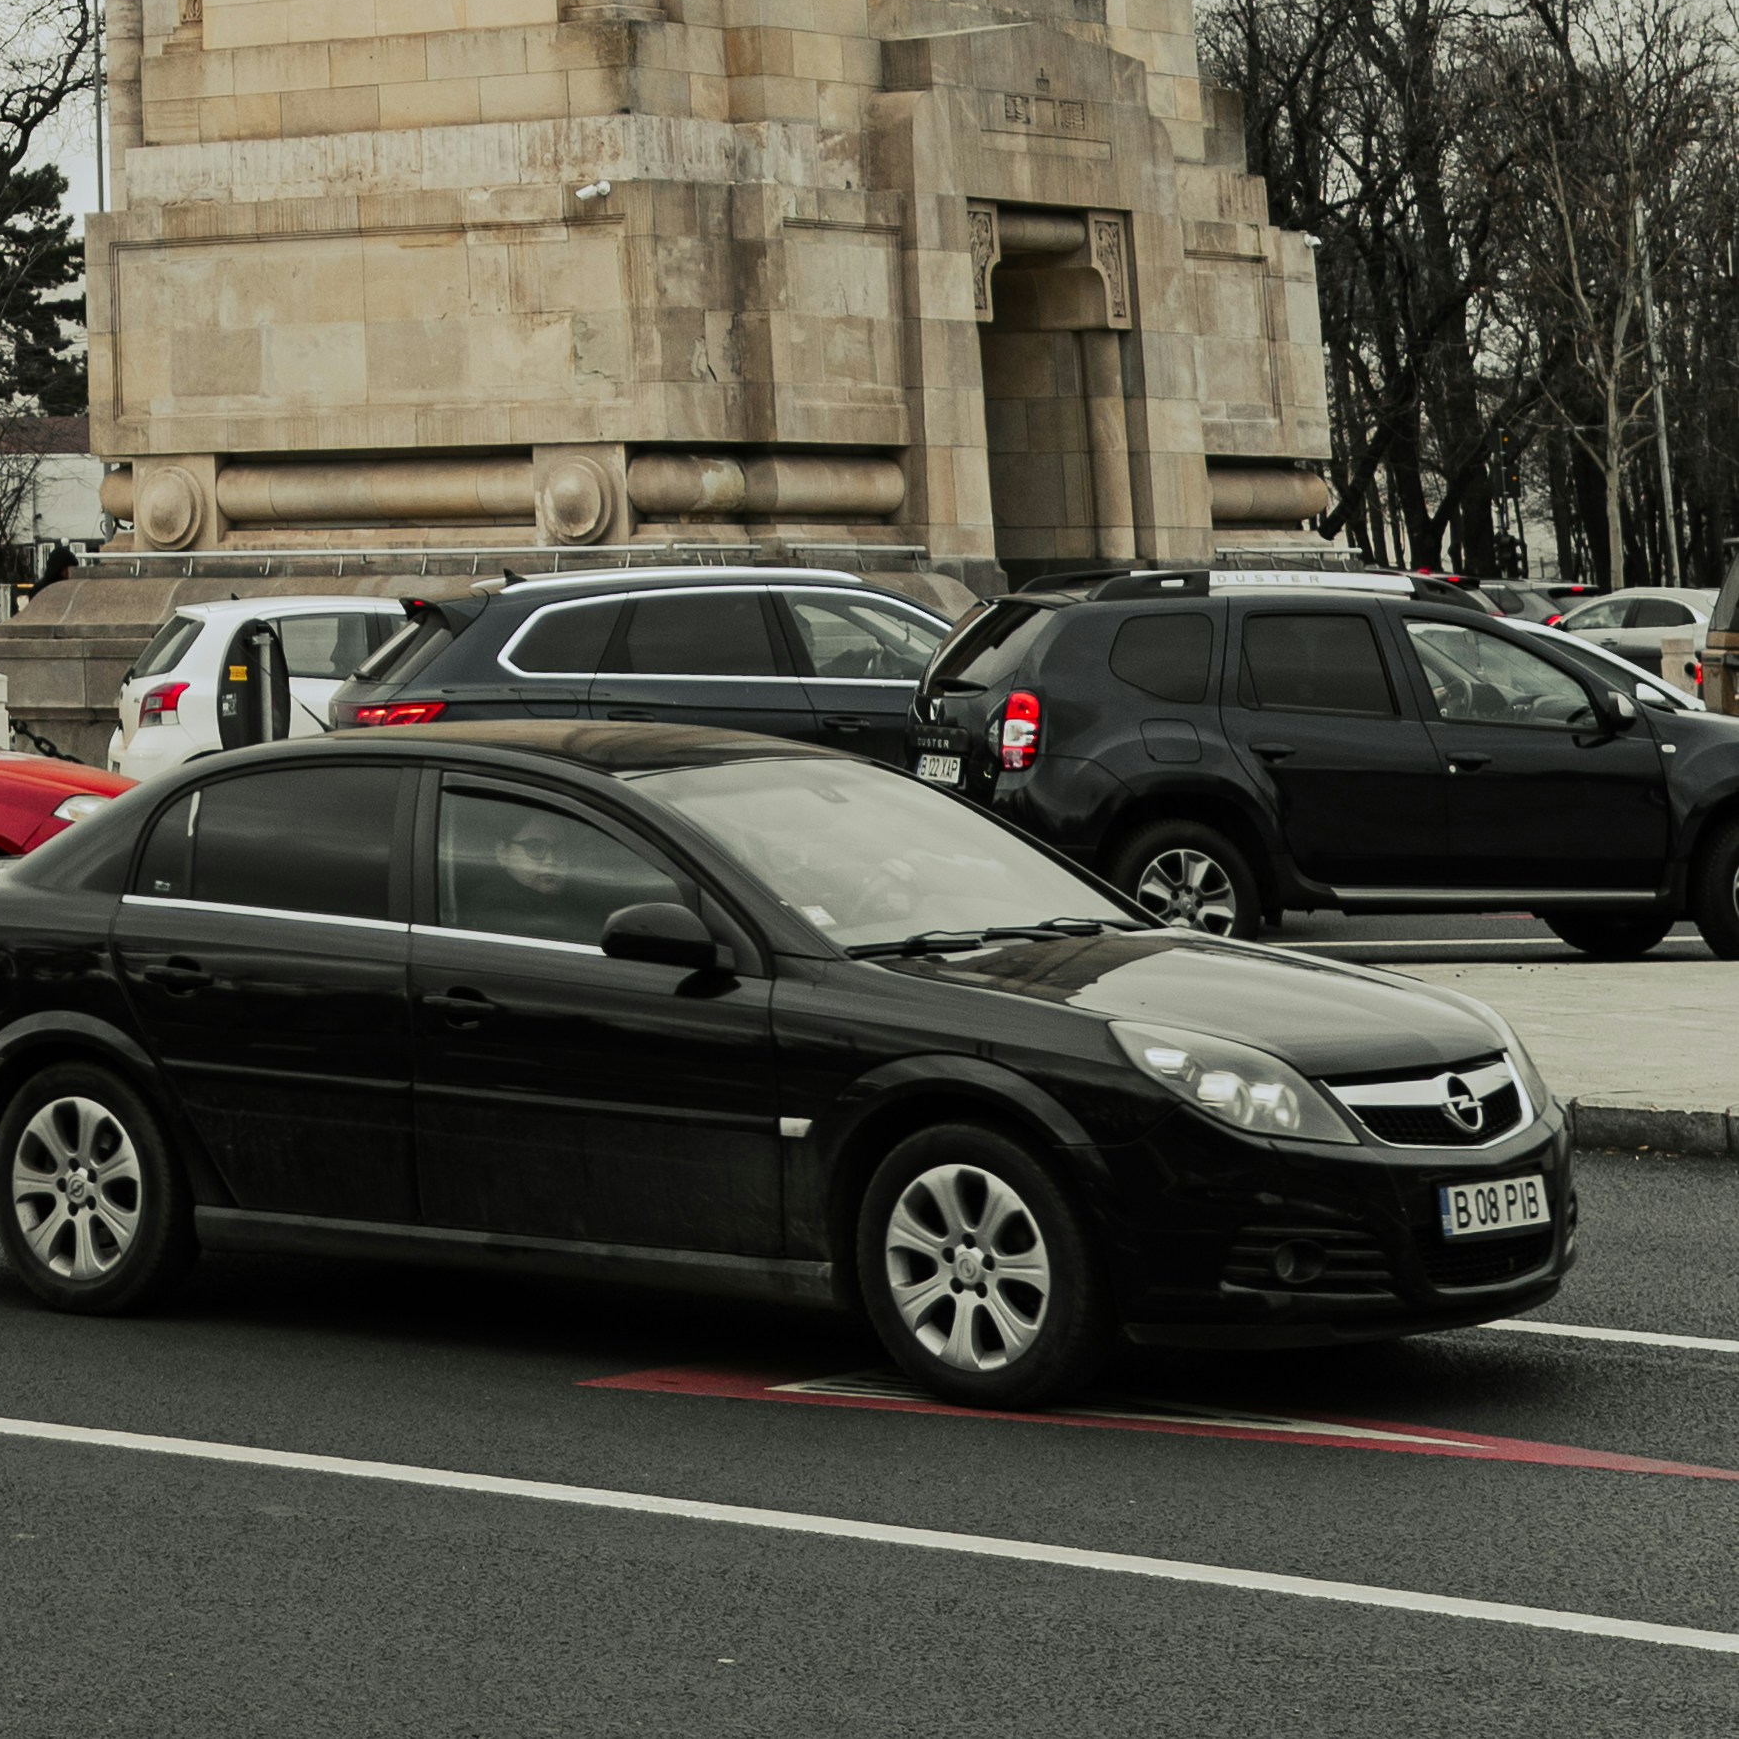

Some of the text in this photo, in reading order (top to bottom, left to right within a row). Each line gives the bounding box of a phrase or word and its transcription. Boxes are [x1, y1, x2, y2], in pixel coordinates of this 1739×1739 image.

[1216, 574, 1320, 584] DUSTER
[917, 737, 950, 749] DUSTER
[920, 756, 928, 776] B
[940, 758, 958, 779] XAP
[1454, 1181, 1540, 1229] B 08 PIB
